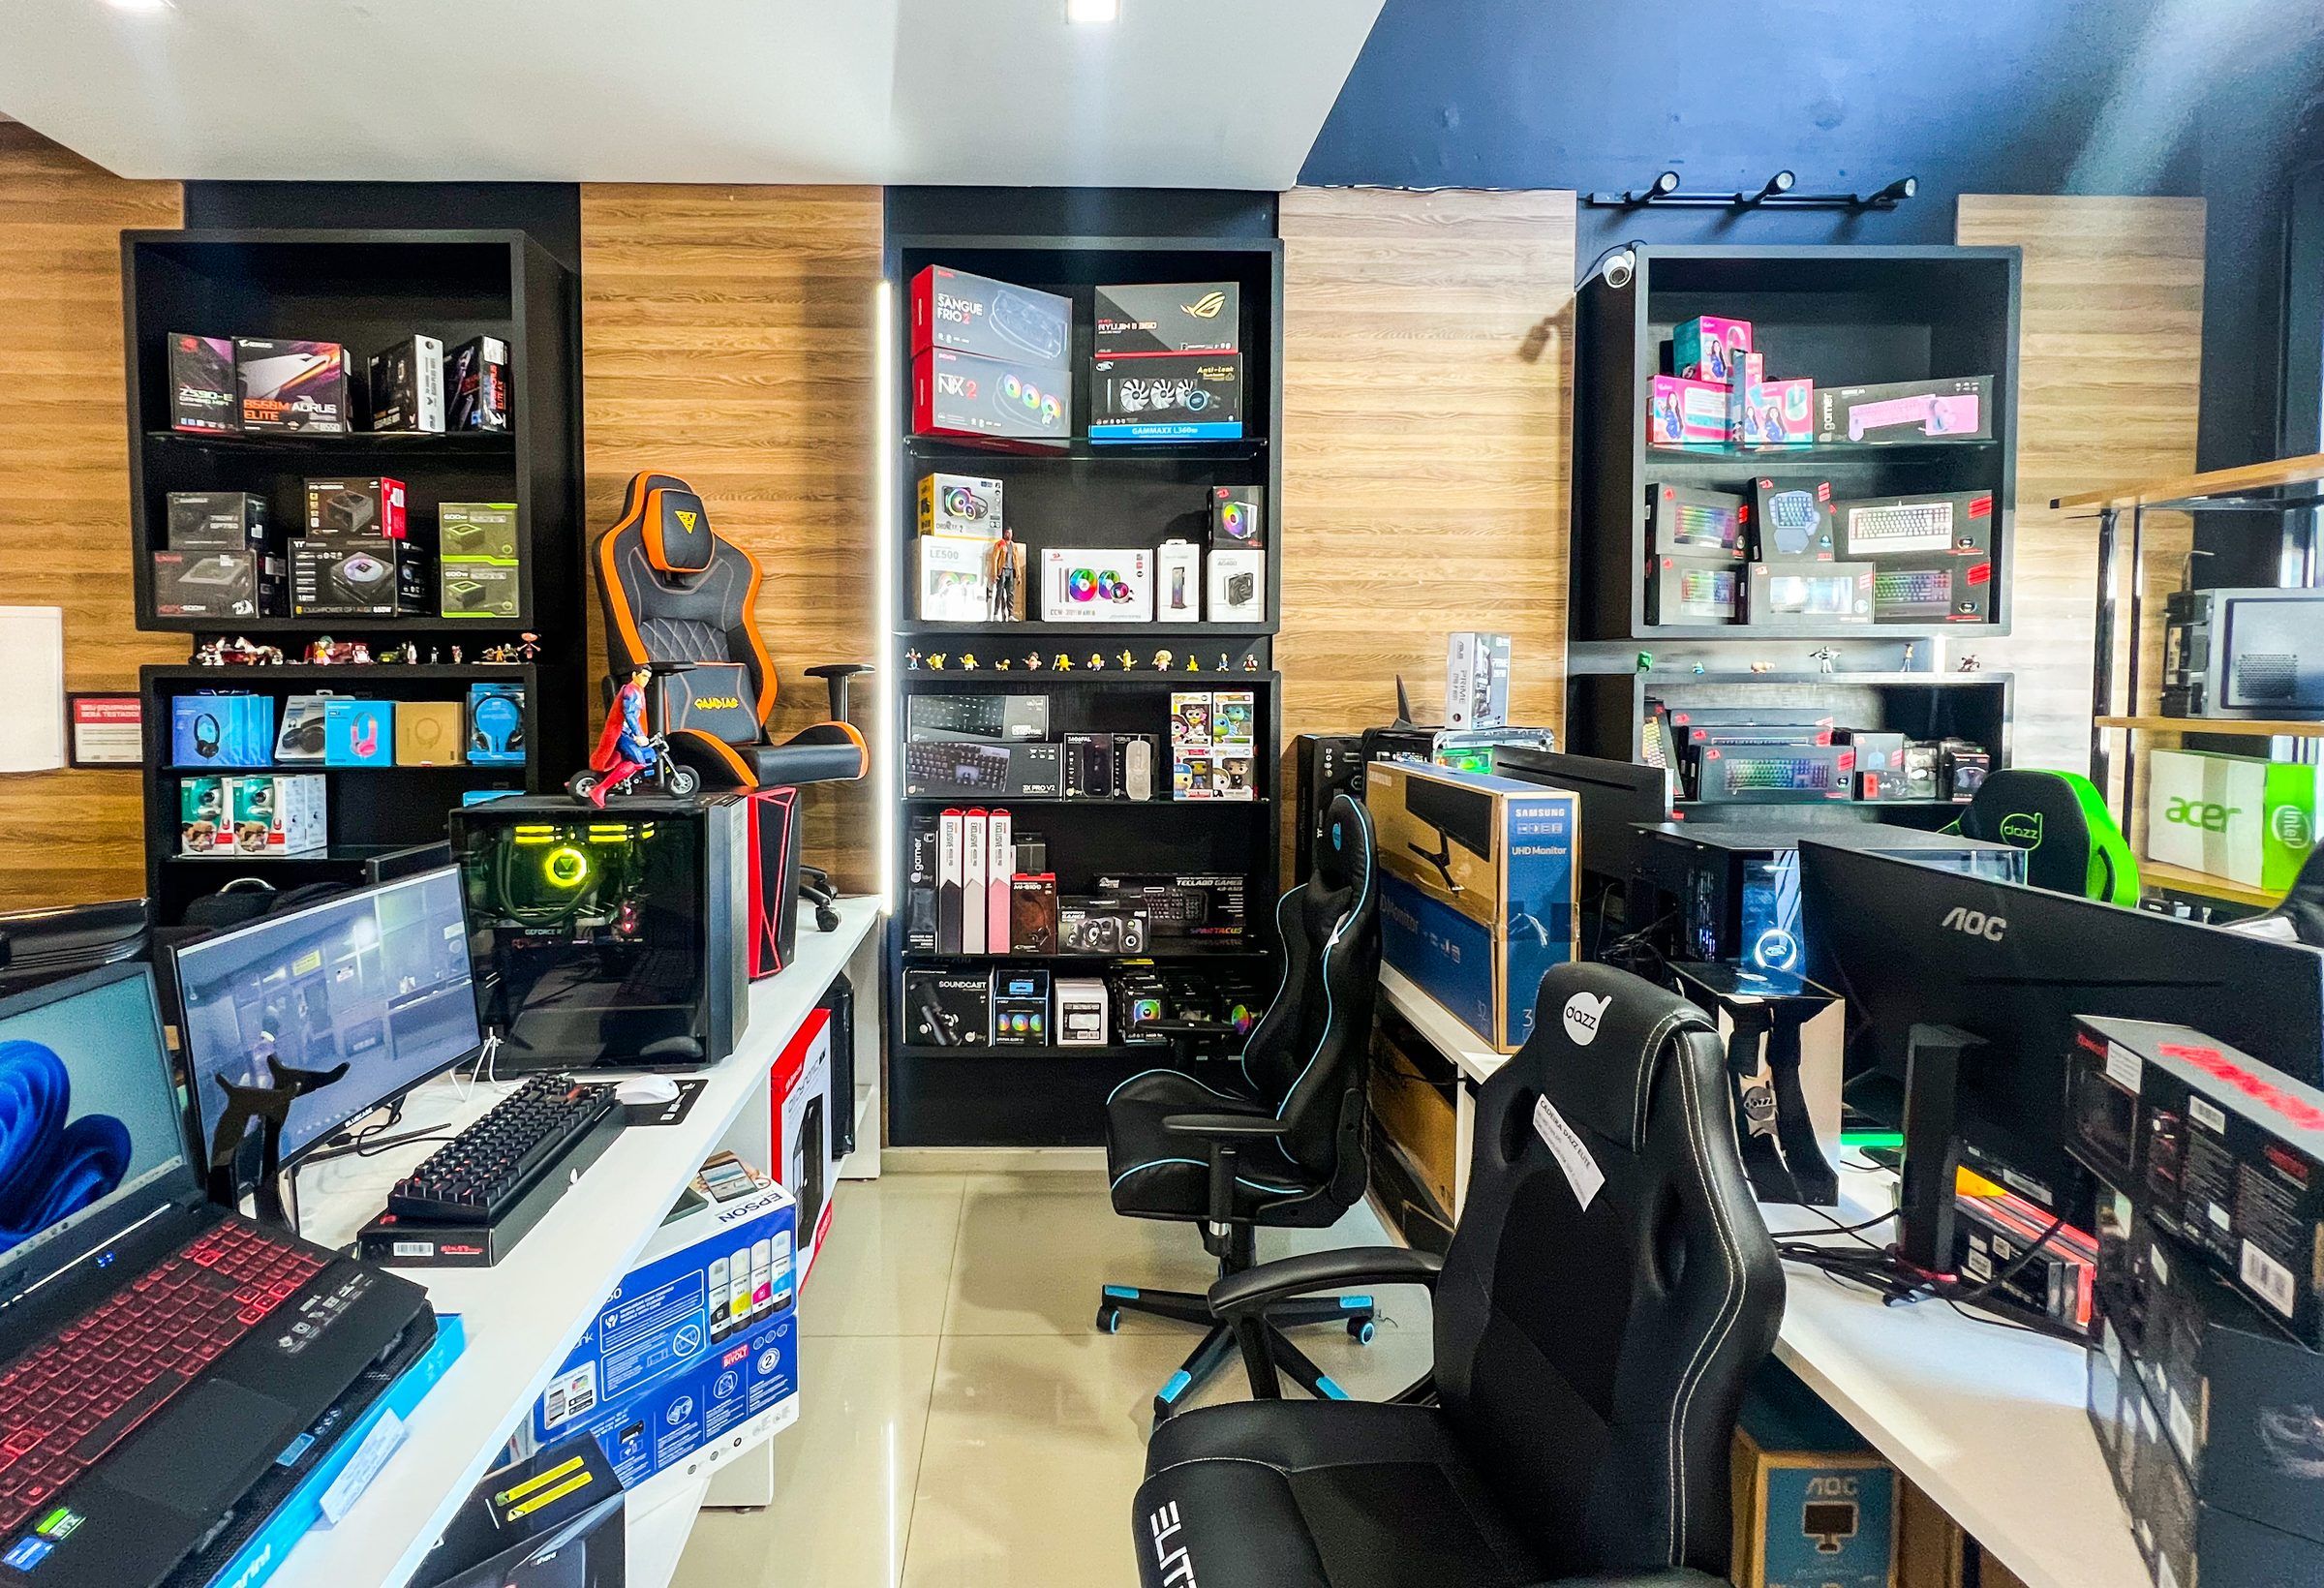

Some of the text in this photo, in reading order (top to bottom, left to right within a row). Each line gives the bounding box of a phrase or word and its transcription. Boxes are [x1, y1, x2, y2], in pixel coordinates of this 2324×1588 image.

[936, 293, 984, 317] SANGUE
[936, 308, 972, 324] FRIO 2
[1138, 321, 1158, 330] 360
[179, 387, 233, 402] Z590-E
[965, 381, 978, 399] 2
[244, 410, 279, 421] ELITE
[291, 403, 337, 414] AORUS
[1823, 392, 1836, 431] gamer
[1132, 425, 1172, 436] GAMMAXX
[930, 549, 959, 561] LE500
[1458, 669, 1468, 705] PRIME
[1514, 808, 1566, 818] SAMSUNG
[2165, 795, 2242, 833] acer
[2003, 824, 2039, 840] dazz
[2282, 810, 2304, 843] intel
[914, 838, 925, 871] gamer
[1512, 845, 1568, 856] UHD Monitor
[1942, 906, 2007, 941] AOC
[1565, 1005, 1597, 1031] dazz
[1540, 1100, 1591, 1170] CADEIRA DAZZ ELITE
[719, 1192, 783, 1224] EPSON
[723, 1346, 749, 1367] BIVOLT
[764, 1355, 773, 1366] 2
[1805, 1476, 1858, 1496] AOC
[1149, 1500, 1198, 1588] ELIT
